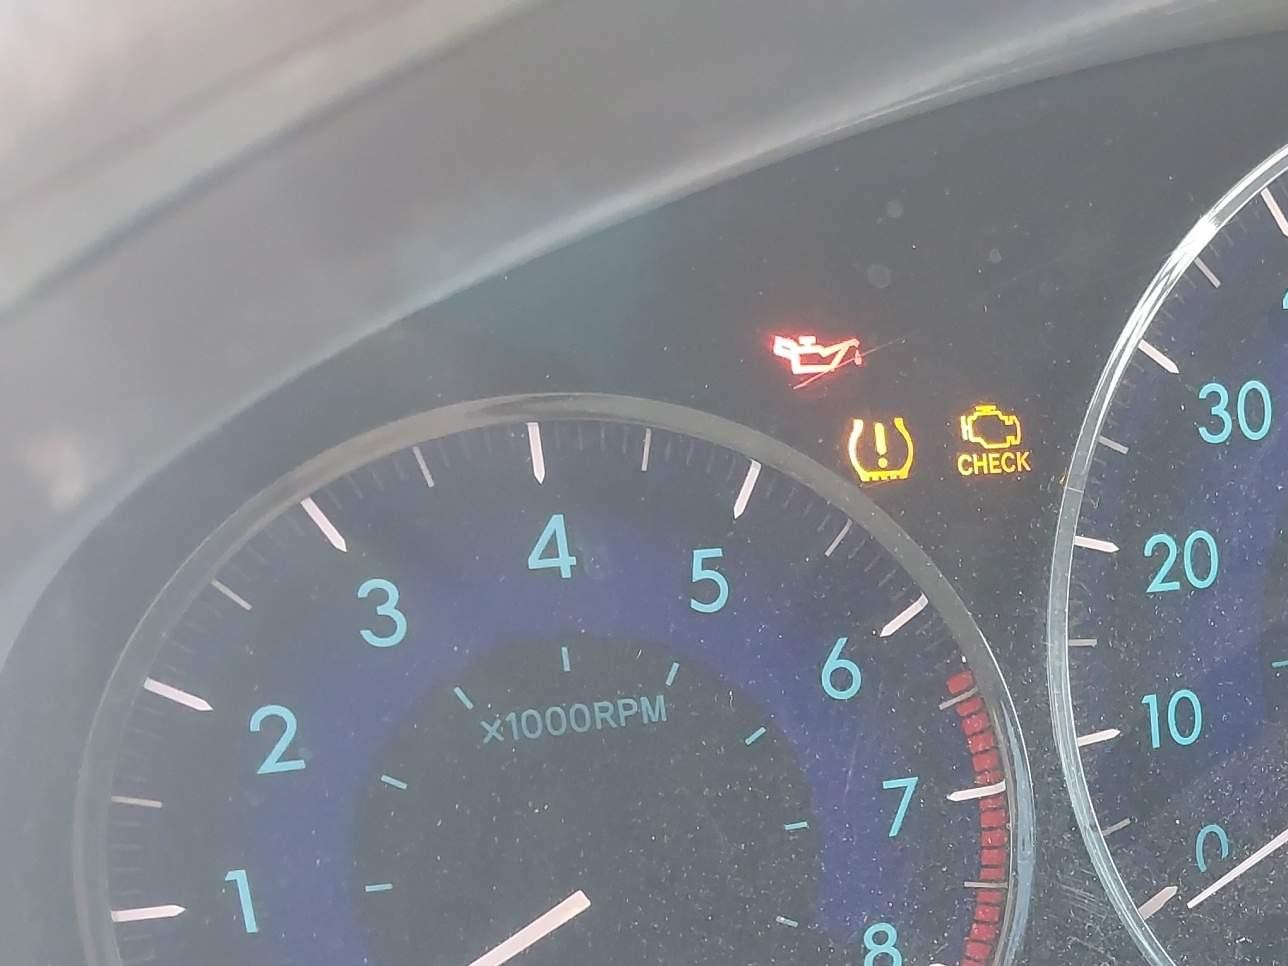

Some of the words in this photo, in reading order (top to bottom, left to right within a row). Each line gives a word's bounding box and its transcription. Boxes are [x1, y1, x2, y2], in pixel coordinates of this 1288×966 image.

[1198, 380, 1272, 444] 30
[957, 451, 1031, 476] CHECK
[528, 514, 577, 578] 4
[1144, 530, 1219, 593] 20
[690, 547, 729, 612] 5
[359, 578, 408, 648] 3
[822, 637, 862, 700] 6
[249, 705, 306, 775] 2
[1142, 689, 1203, 749] 10
[882, 776, 919, 837] 7
[224, 868, 260, 934] 1
